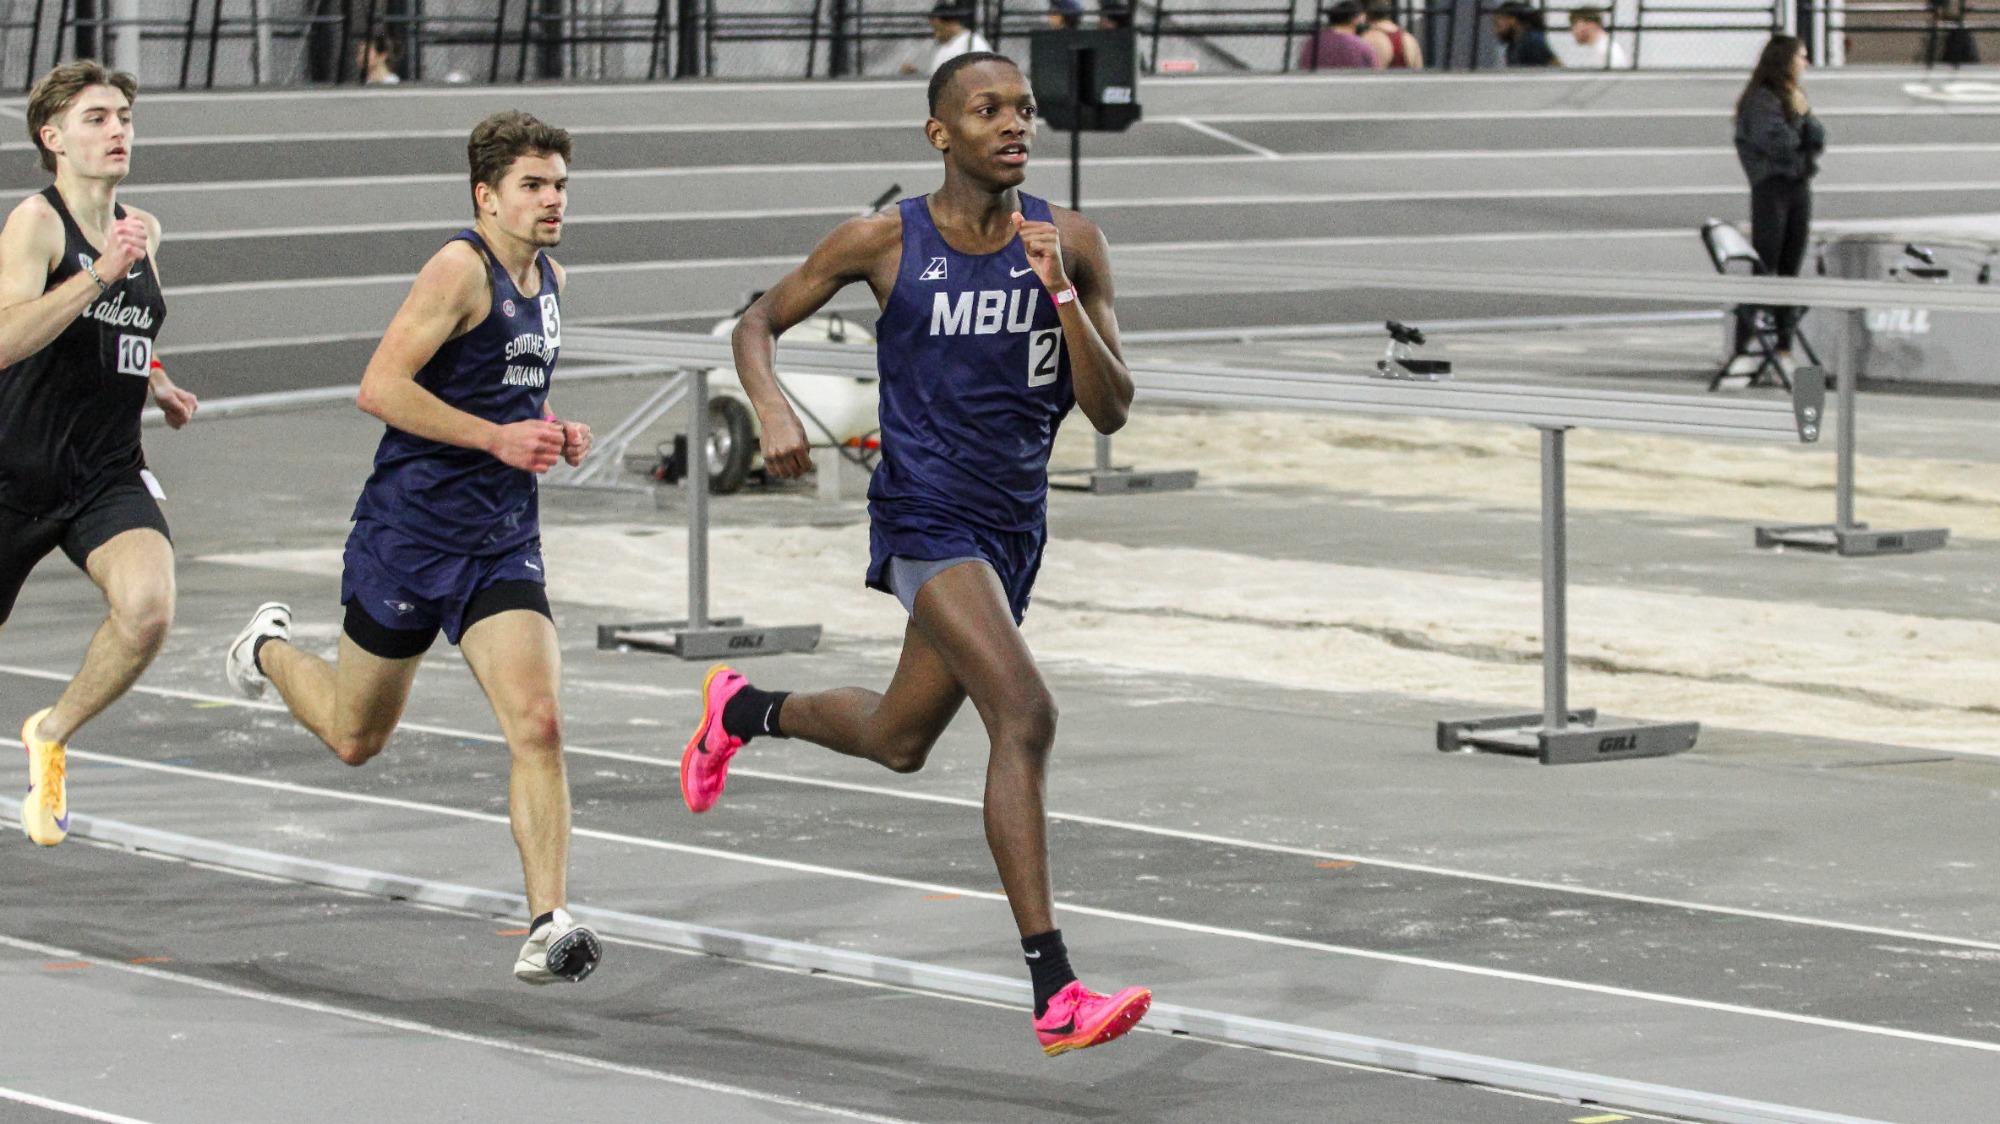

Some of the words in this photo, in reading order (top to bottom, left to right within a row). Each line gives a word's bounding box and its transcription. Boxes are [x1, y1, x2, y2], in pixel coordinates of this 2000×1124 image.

[543, 296, 559, 339] 3
[929, 288, 1039, 336] MBU
[121, 338, 147, 371] 10
[1034, 331, 1058, 377] 2
[502, 365, 545, 388] INDIANA
[1598, 734, 1637, 753] GILL
